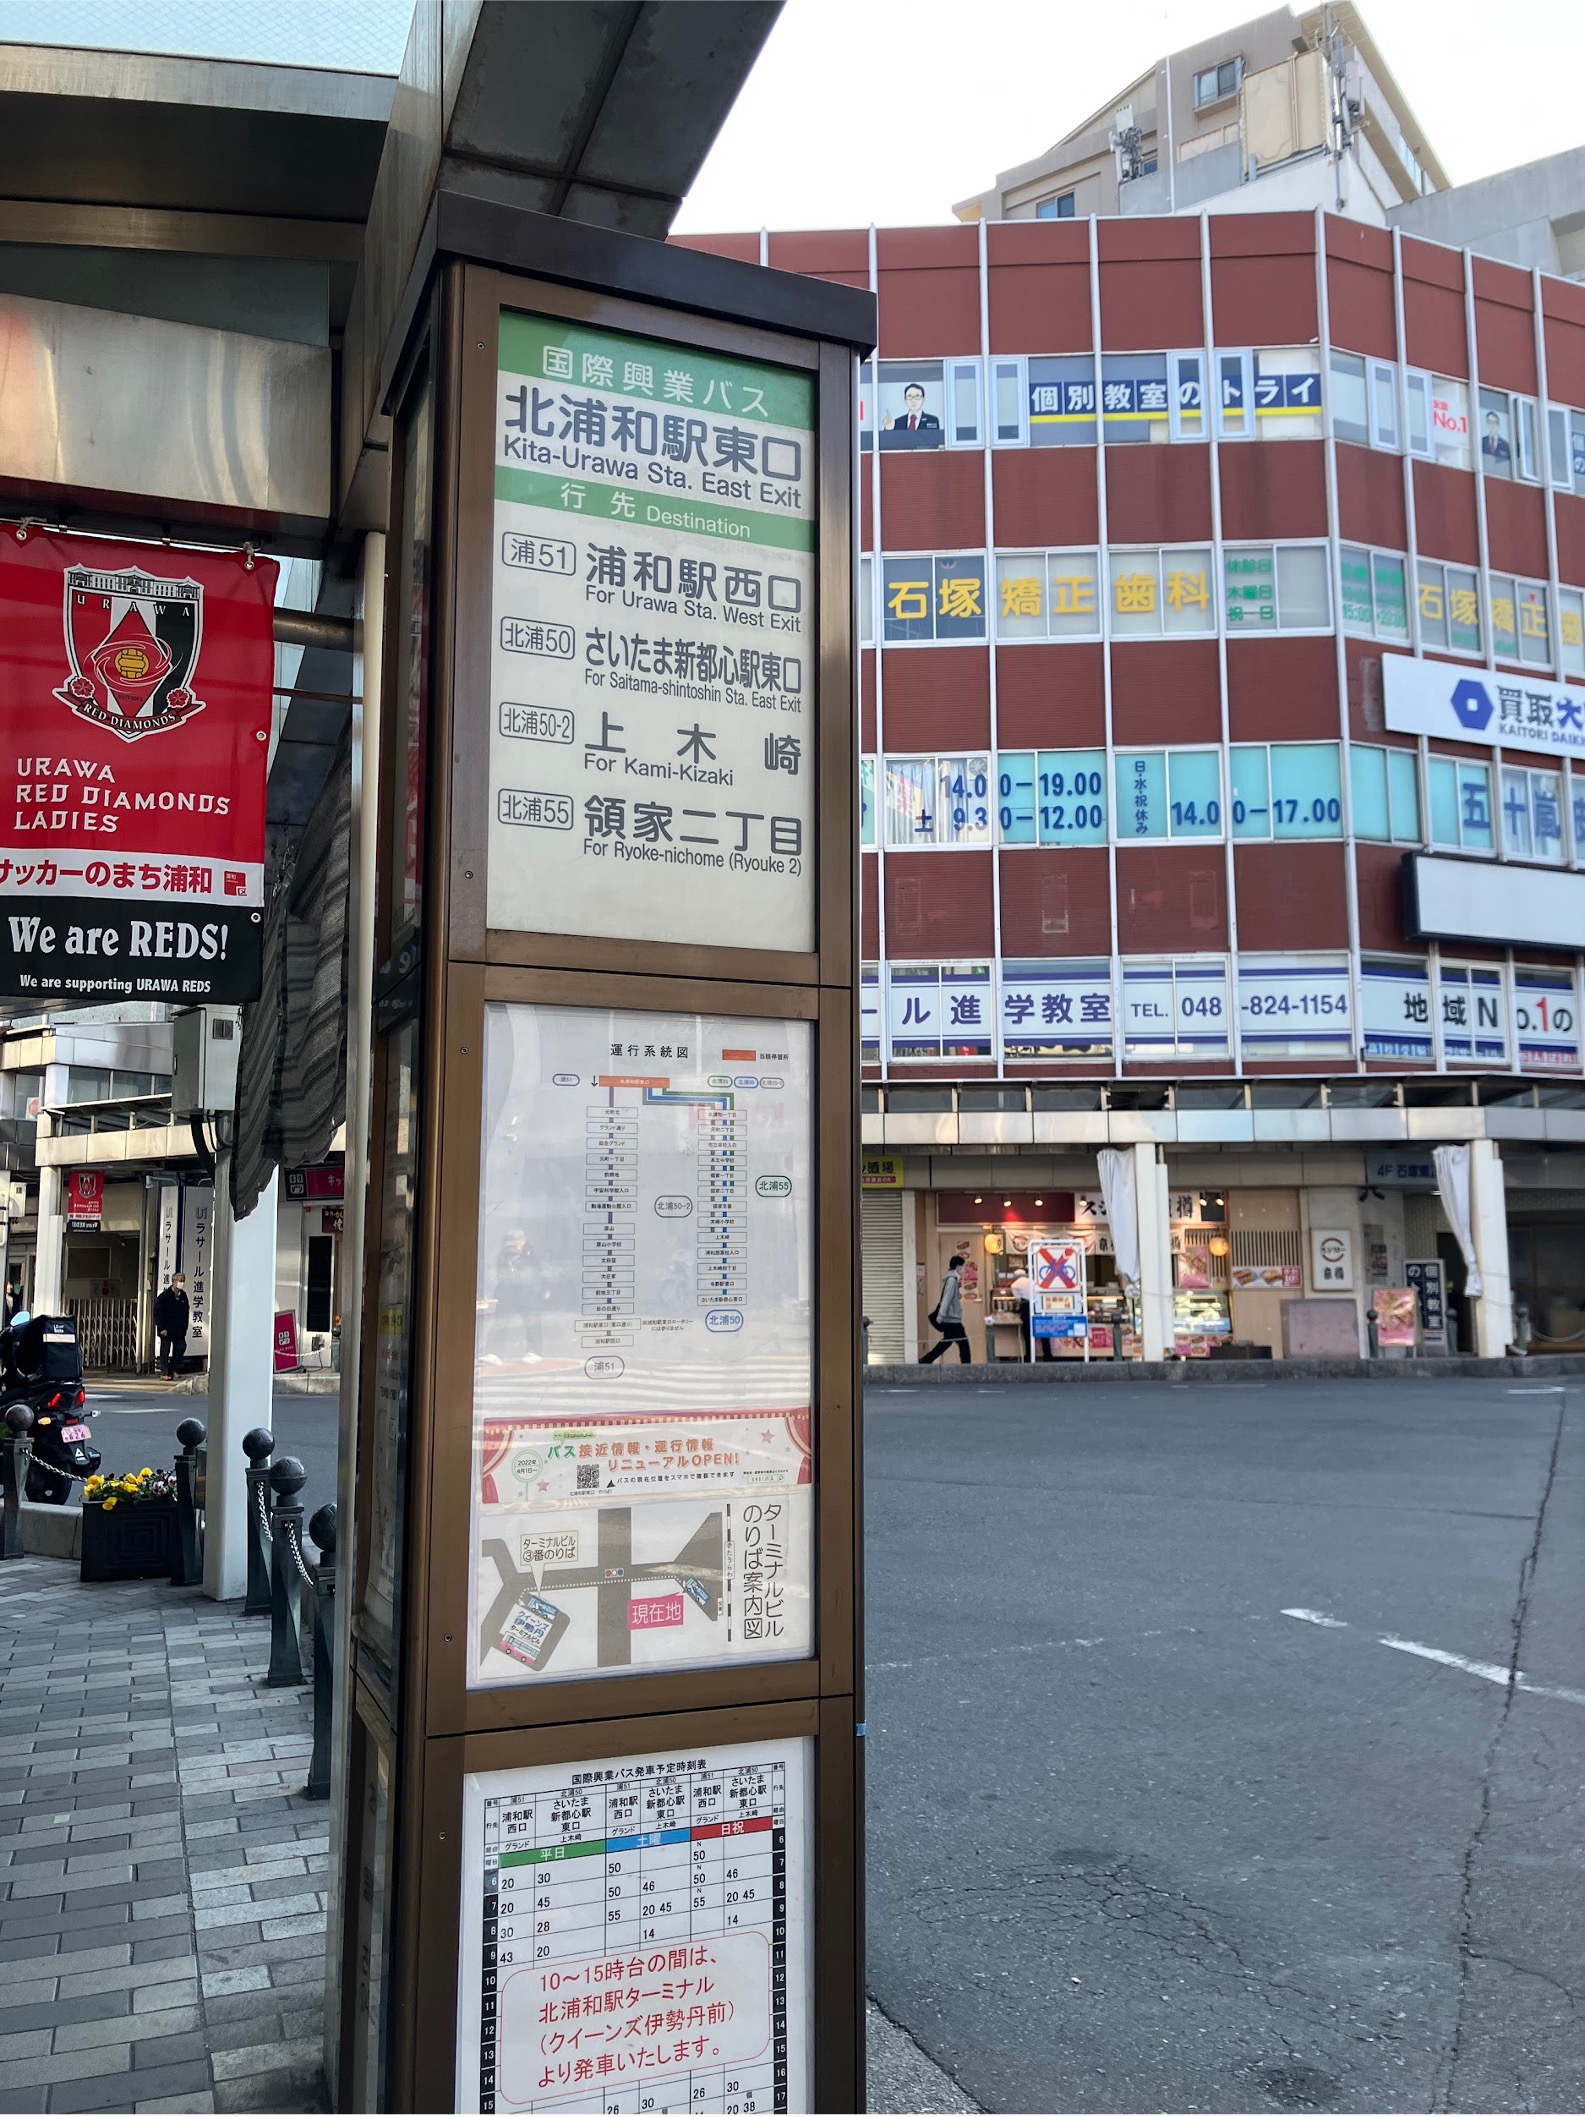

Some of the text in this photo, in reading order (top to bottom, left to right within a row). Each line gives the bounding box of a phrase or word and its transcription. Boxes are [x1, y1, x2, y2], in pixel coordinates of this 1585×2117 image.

[543, 346, 768, 417] 国際興業バス
[1031, 377, 1316, 412] 個別教室のトライ
[1434, 411, 1466, 432] No.1
[505, 385, 801, 481] 北浦和駅東口
[504, 435, 801, 509] Kita-Urawa Sta. East Exit
[561, 483, 750, 539] 行先 Destination
[511, 538, 566, 569] 浦51
[586, 542, 800, 613] 浦和駅西口
[888, 571, 1209, 620] 石塚矯正歯科
[77, 595, 189, 617] URAWA
[586, 585, 801, 632] For Urawa Sta. West Exit
[505, 623, 571, 653] 北浦50
[586, 627, 800, 694] さいたま新都心駅東口
[585, 669, 801, 713] For Saitama-shintoshin Sta. East Exit
[83, 703, 175, 730] RED DIAMONDS
[1497, 686, 1585, 730] 買取大
[504, 708, 570, 738] 北浦50-2
[1499, 724, 1548, 740] KAITORI
[585, 712, 801, 775] 上木崎
[18, 757, 115, 783] URAWA
[585, 754, 733, 786] For Kami-Kizaki
[16, 784, 230, 815] RED DIAMONDS
[503, 795, 569, 824] 北浦55
[14, 810, 120, 832] LADIES
[585, 795, 801, 856] 領家二丁目
[914, 809, 933, 832] 土
[584, 839, 801, 876] For Ryoke-nichome (Ryouke 2)
[0, 859, 212, 894] サッカーのまち浦和
[9, 916, 228, 960] We are REDS!
[20, 975, 210, 994] We are supporting URAWA REDS
[1130, 1002, 1168, 1018] TEL.
[610, 1044, 688, 1058] 運行系統図
[759, 1180, 789, 1191] 北浦55
[657, 1202, 690, 1211] 北浦50-2
[192, 1223, 205, 1338] ラサール進学教室
[709, 1315, 741, 1326] 北浦50
[594, 1361, 615, 1372] 浦51
[548, 1438, 714, 1459] バス接近情報・運行情報
[608, 1453, 740, 1472] リニューアルOPEN!
[523, 1537, 576, 1549] ターミナルビル
[743, 1505, 763, 1639] のりば案内図
[765, 1504, 784, 1638] ターミナルビル
[632, 1603, 681, 1623] 現在地
[572, 1759, 707, 1785] 国際興業バス発車予定時刻表
[554, 1797, 589, 1809] さいたま
[502, 1809, 533, 1822] 浦和駅
[551, 1808, 591, 1822] 新都心駅
[508, 1823, 527, 1834] 西口
[562, 1822, 580, 1832] 東口
[722, 1821, 744, 1835] 日祝
[505, 1841, 529, 1850] グランド
[561, 1834, 581, 1843] 上木崎
[637, 1834, 661, 1846] 土曜
[541, 1847, 565, 1861] 平日
[693, 1850, 705, 1860] 50
[608, 1863, 621, 1874] 50
[726, 1869, 738, 1879] 46
[502, 1878, 514, 1889] 20
[538, 1873, 550, 1884] 30
[643, 1881, 655, 1892] 46
[608, 1887, 621, 1897] 50
[726, 1889, 755, 1903] 20 45
[501, 1903, 514, 1914] 20
[538, 1897, 550, 1908] 45
[643, 1902, 672, 1916] 20 45
[693, 1897, 706, 1908] 55
[608, 1910, 621, 1921] 55
[501, 1927, 513, 1938] 30
[537, 1922, 549, 1932] 28
[500, 1952, 513, 1963] 43
[537, 1946, 549, 1957] 20
[541, 1946, 717, 1991] 10〜15時台の間は、
[538, 1976, 714, 2023] 北浦和駅ターミナル
[541, 2001, 734, 2055] (クイーンズ伊勢丹前)
[538, 2036, 719, 2088] より発車いたします。
[693, 2088, 705, 2099] 26
[727, 2081, 739, 2092] 30
[642, 2098, 654, 2109] 30
[743, 2102, 755, 2112] 38
